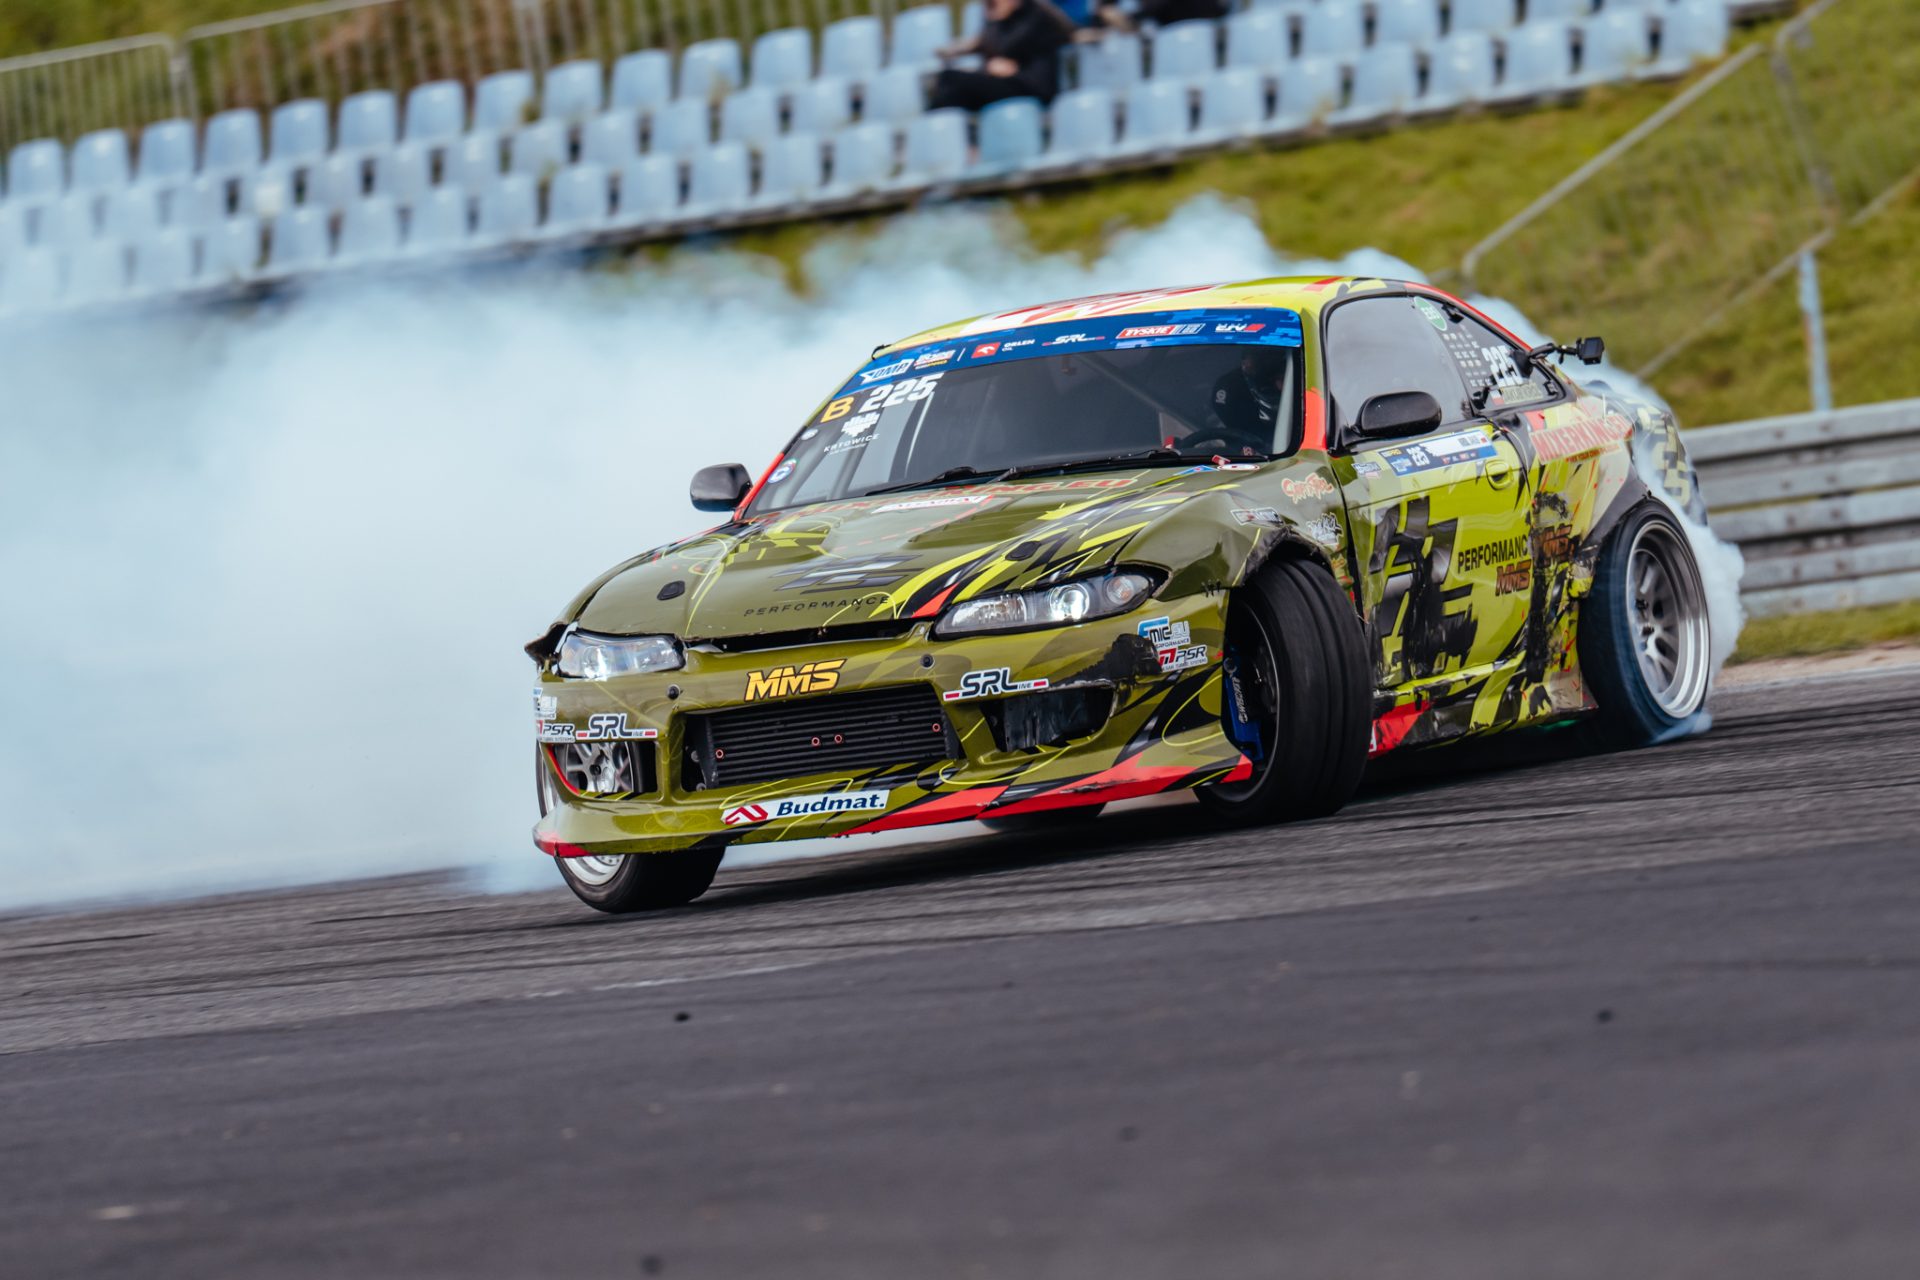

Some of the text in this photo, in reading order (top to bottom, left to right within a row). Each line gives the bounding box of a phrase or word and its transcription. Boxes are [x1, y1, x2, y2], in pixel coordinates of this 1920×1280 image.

[1125, 325, 1171, 337] TYSKIE
[1003, 339, 1036, 348] ORLEN
[859, 373, 945, 414] 225
[820, 397, 855, 423] B
[1457, 534, 1529, 575] PERFORMANC
[1494, 559, 1532, 597] MMS
[743, 595, 890, 617] PERFORMANCE
[1175, 646, 1206, 662] PSR
[744, 659, 847, 702] MMS
[542, 724, 574, 736] PSR
[776, 794, 885, 817] Budmat.
